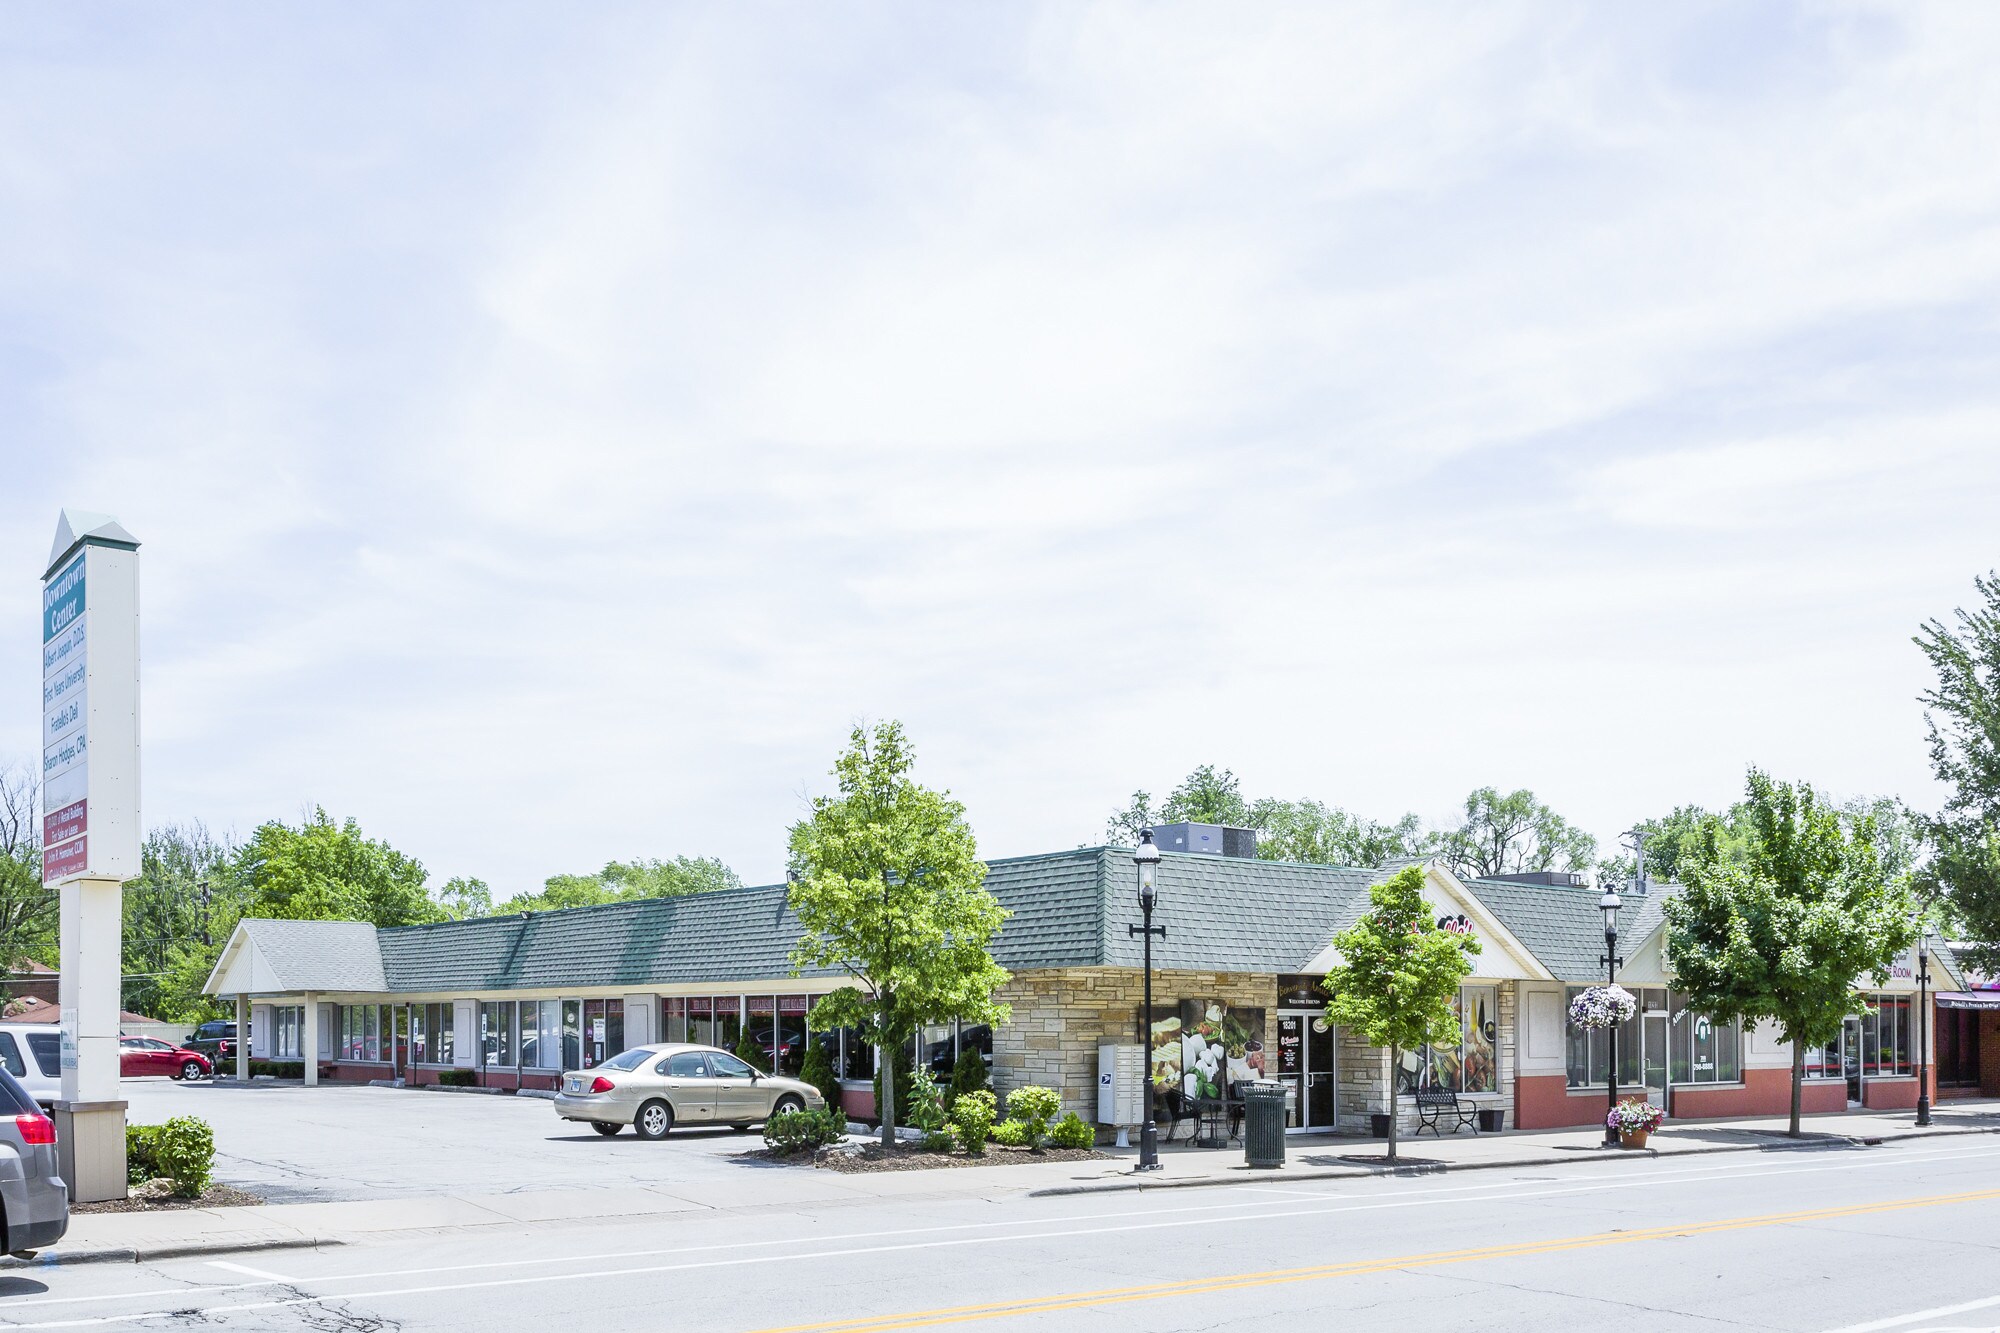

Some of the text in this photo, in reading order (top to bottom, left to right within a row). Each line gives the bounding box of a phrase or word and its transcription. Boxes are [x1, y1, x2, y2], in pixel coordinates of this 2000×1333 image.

[44, 561, 86, 613] Downtown
[51, 598, 77, 633] Center
[45, 648, 57, 669] Albert
[45, 663, 86, 704] First Years University
[51, 701, 79, 734] Fratello's Deli
[44, 734, 87, 772] Sharon Hodges, CPA
[1282, 1020, 1296, 1029] 18201
